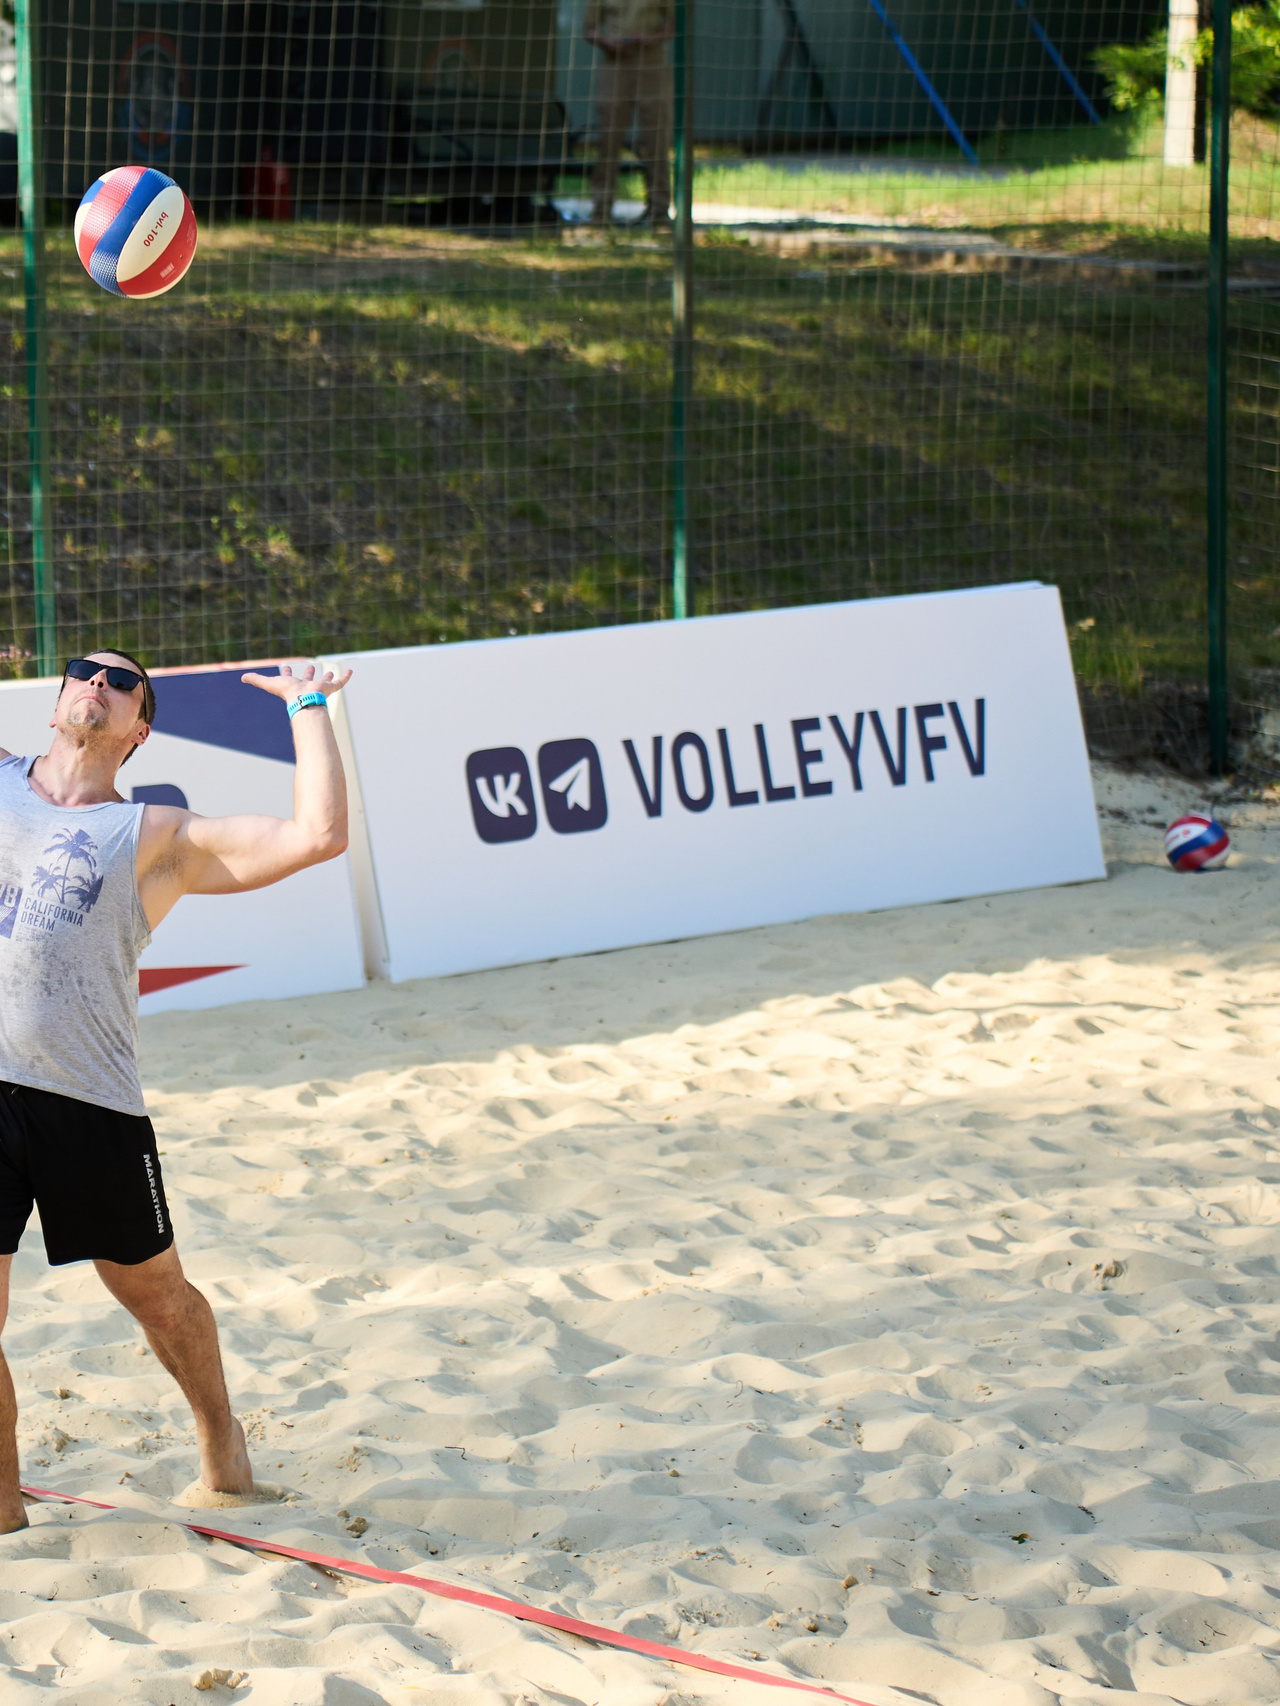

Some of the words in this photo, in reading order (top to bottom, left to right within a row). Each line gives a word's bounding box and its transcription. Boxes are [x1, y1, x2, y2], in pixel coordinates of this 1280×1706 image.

[621, 698, 985, 819] VOLLEYVFV
[20, 912, 56, 932] DREAM
[24, 897, 84, 927] CALIFORNIA
[142, 1153, 165, 1234] MARATHON
